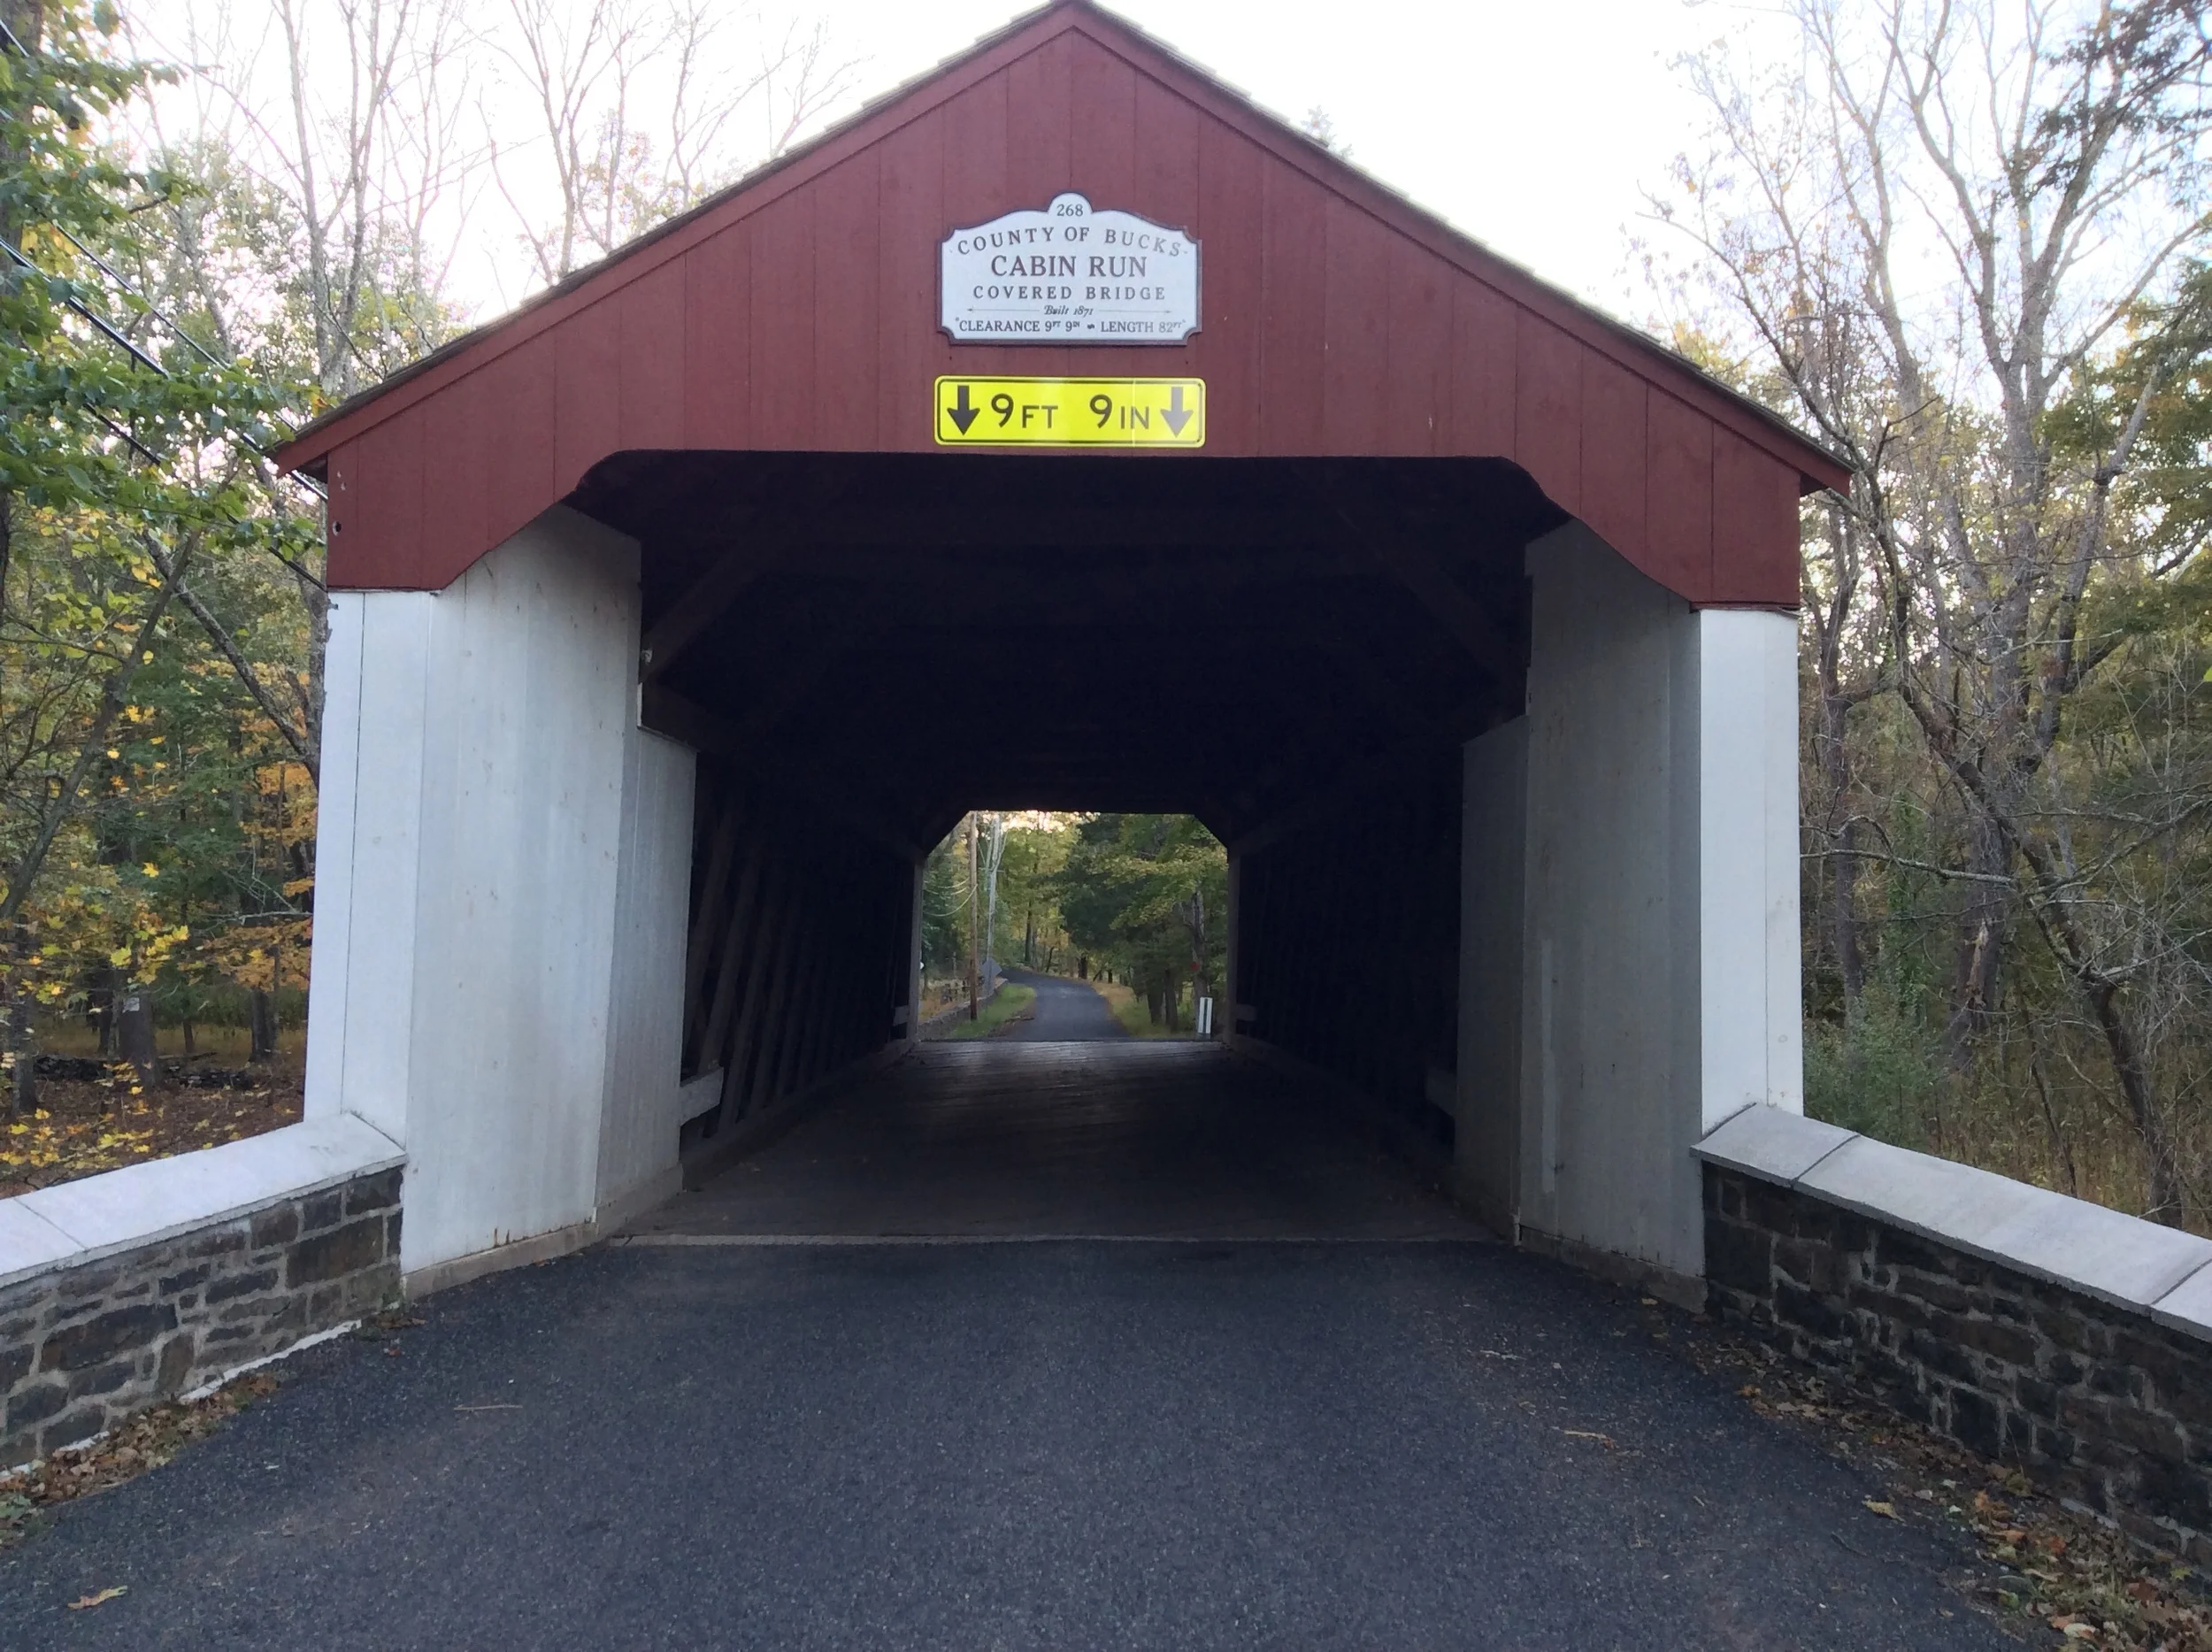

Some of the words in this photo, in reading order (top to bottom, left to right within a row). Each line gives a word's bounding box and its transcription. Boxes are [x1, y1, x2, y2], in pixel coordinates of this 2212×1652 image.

[1056, 204, 1083, 217] 268
[957, 227, 1055, 255] COUNTY
[1064, 227, 1090, 242] OF
[1104, 228, 1181, 257] BUCKS
[991, 255, 1077, 277] CABIN
[1089, 256, 1148, 277] RUN
[973, 285, 1072, 300] COVERED
[1086, 286, 1166, 301] BRIDGE
[1044, 304, 1069, 315] Built
[1073, 305, 1094, 318] 1871
[958, 319, 1041, 332] CLEARANCE
[1101, 321, 1154, 333] LENGTH
